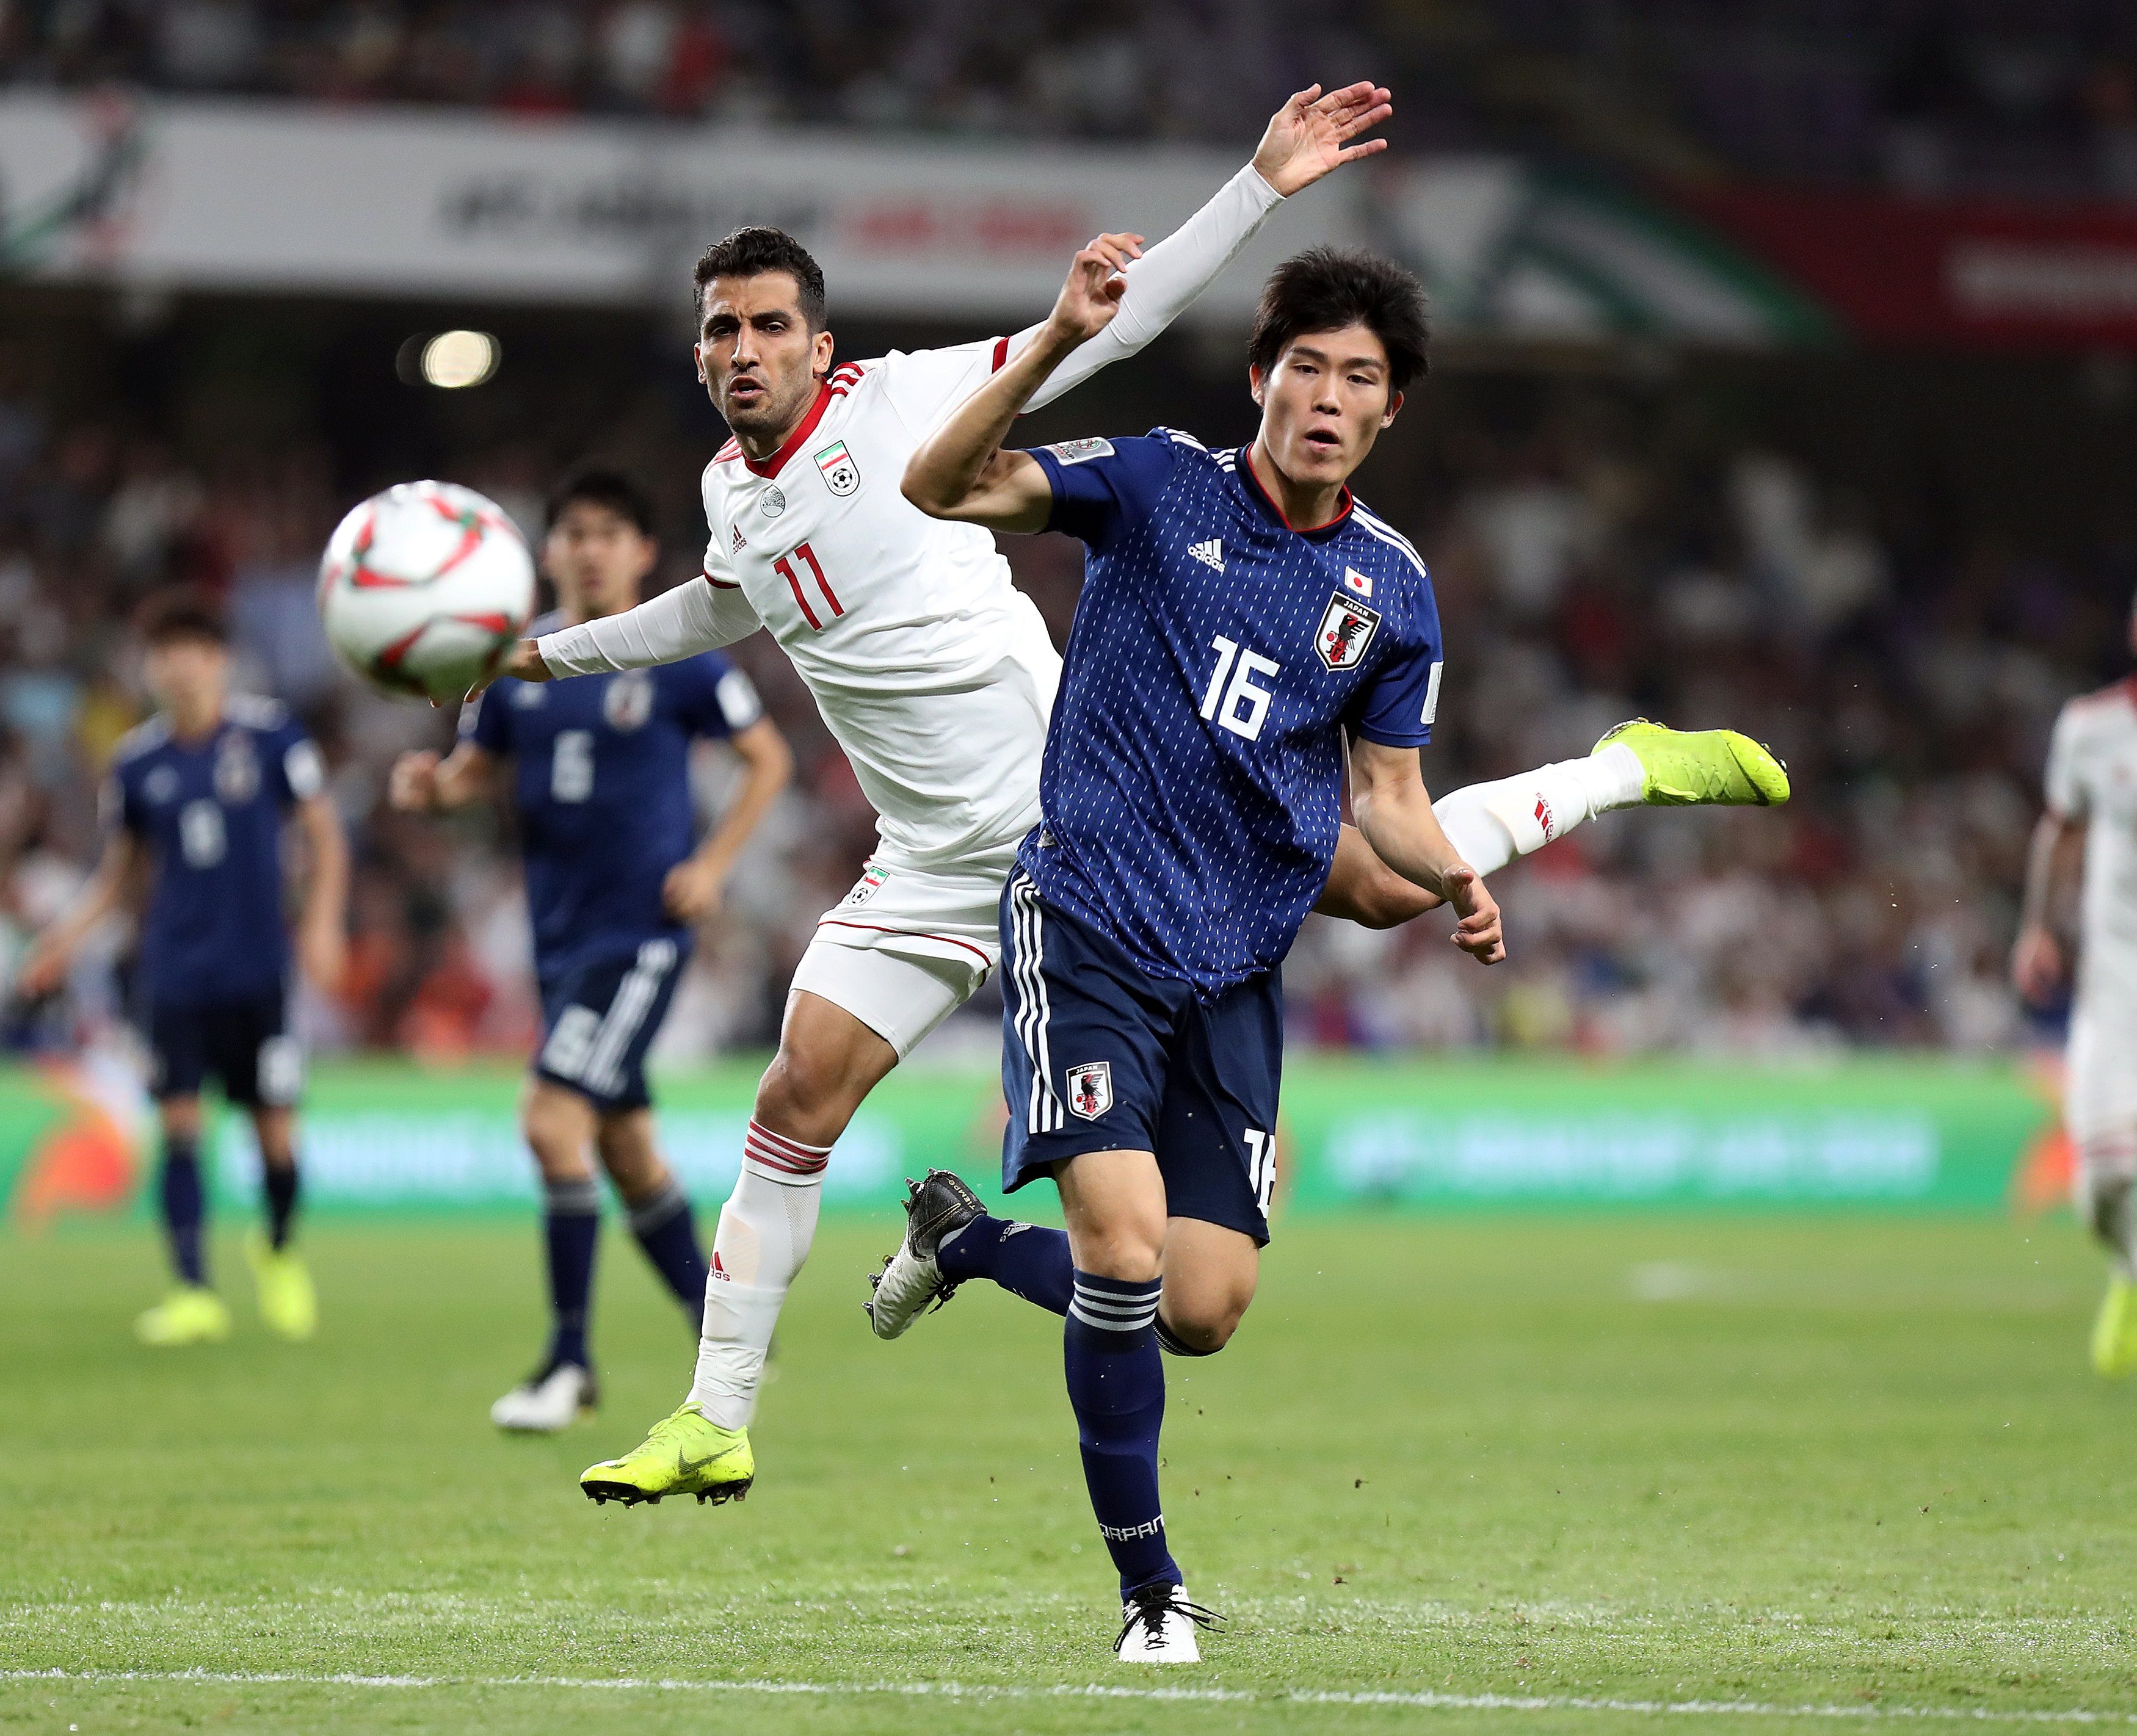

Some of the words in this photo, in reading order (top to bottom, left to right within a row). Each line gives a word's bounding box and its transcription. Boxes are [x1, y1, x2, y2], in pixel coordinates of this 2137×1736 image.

[1188, 546, 1225, 573] adidas
[774, 543, 844, 631] 11
[1343, 601, 1369, 617] JAPAN
[1200, 634, 1280, 742] 16
[1076, 1065, 1098, 1074] JAPAN
[948, 1180, 976, 1210] TIEMPO
